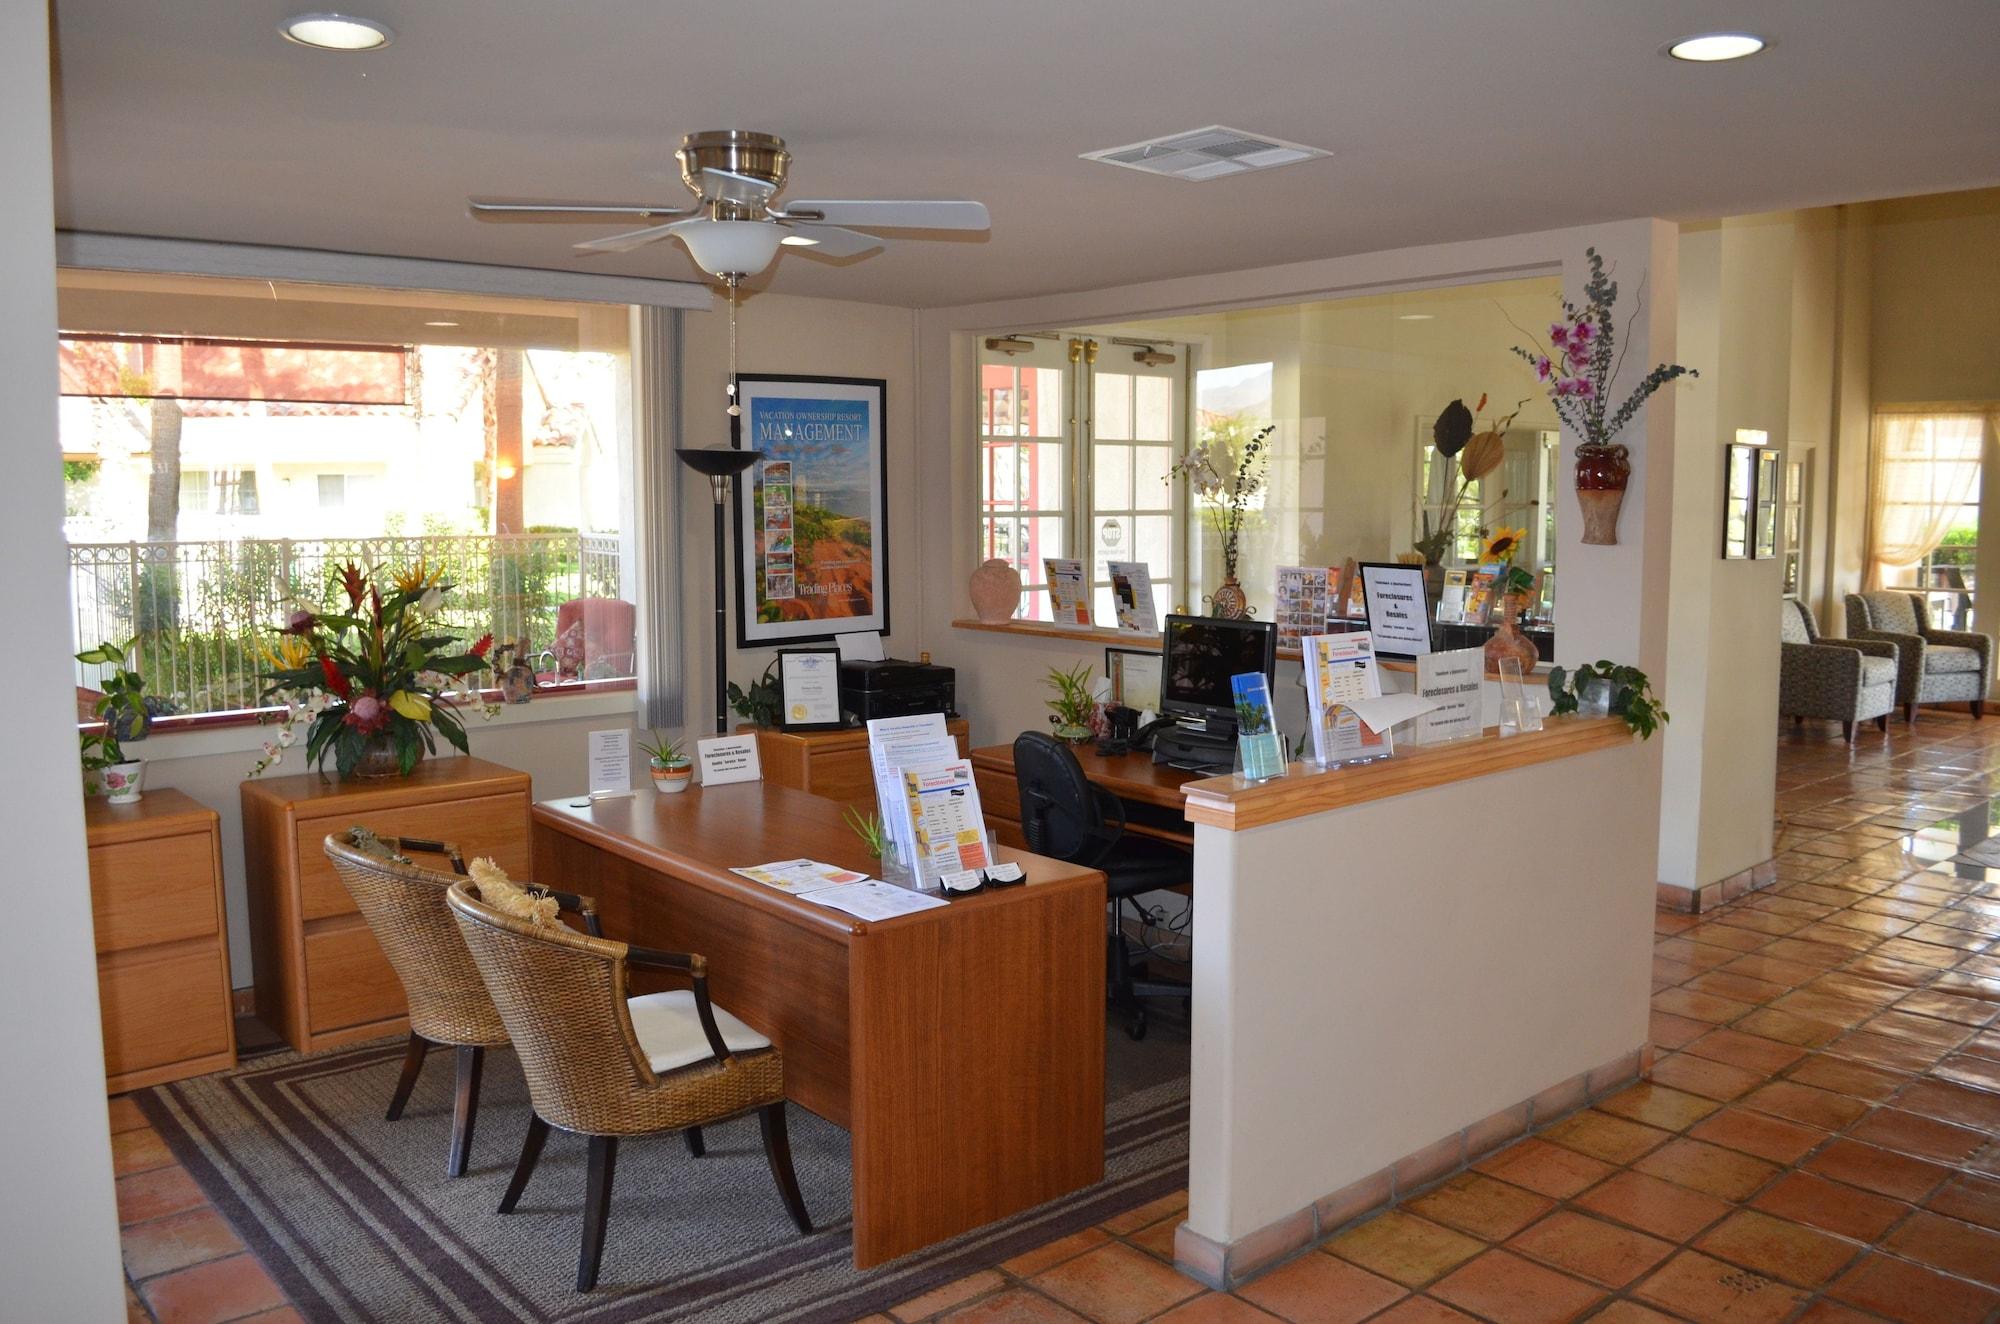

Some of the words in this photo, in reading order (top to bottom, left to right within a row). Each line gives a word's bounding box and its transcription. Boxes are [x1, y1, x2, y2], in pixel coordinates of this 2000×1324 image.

[760, 411, 794, 420] VACATION
[796, 411, 836, 421] OWNERSHIP
[836, 413, 862, 421] RESORT
[760, 422, 862, 441] MANAGEMENT
[798, 583, 828, 596] Trading
[1377, 592, 1413, 601] Foreclosures
[1386, 610, 1408, 619] Resales
[1422, 686, 1455, 697] Foreclosures
[1460, 683, 1478, 692] Resales
